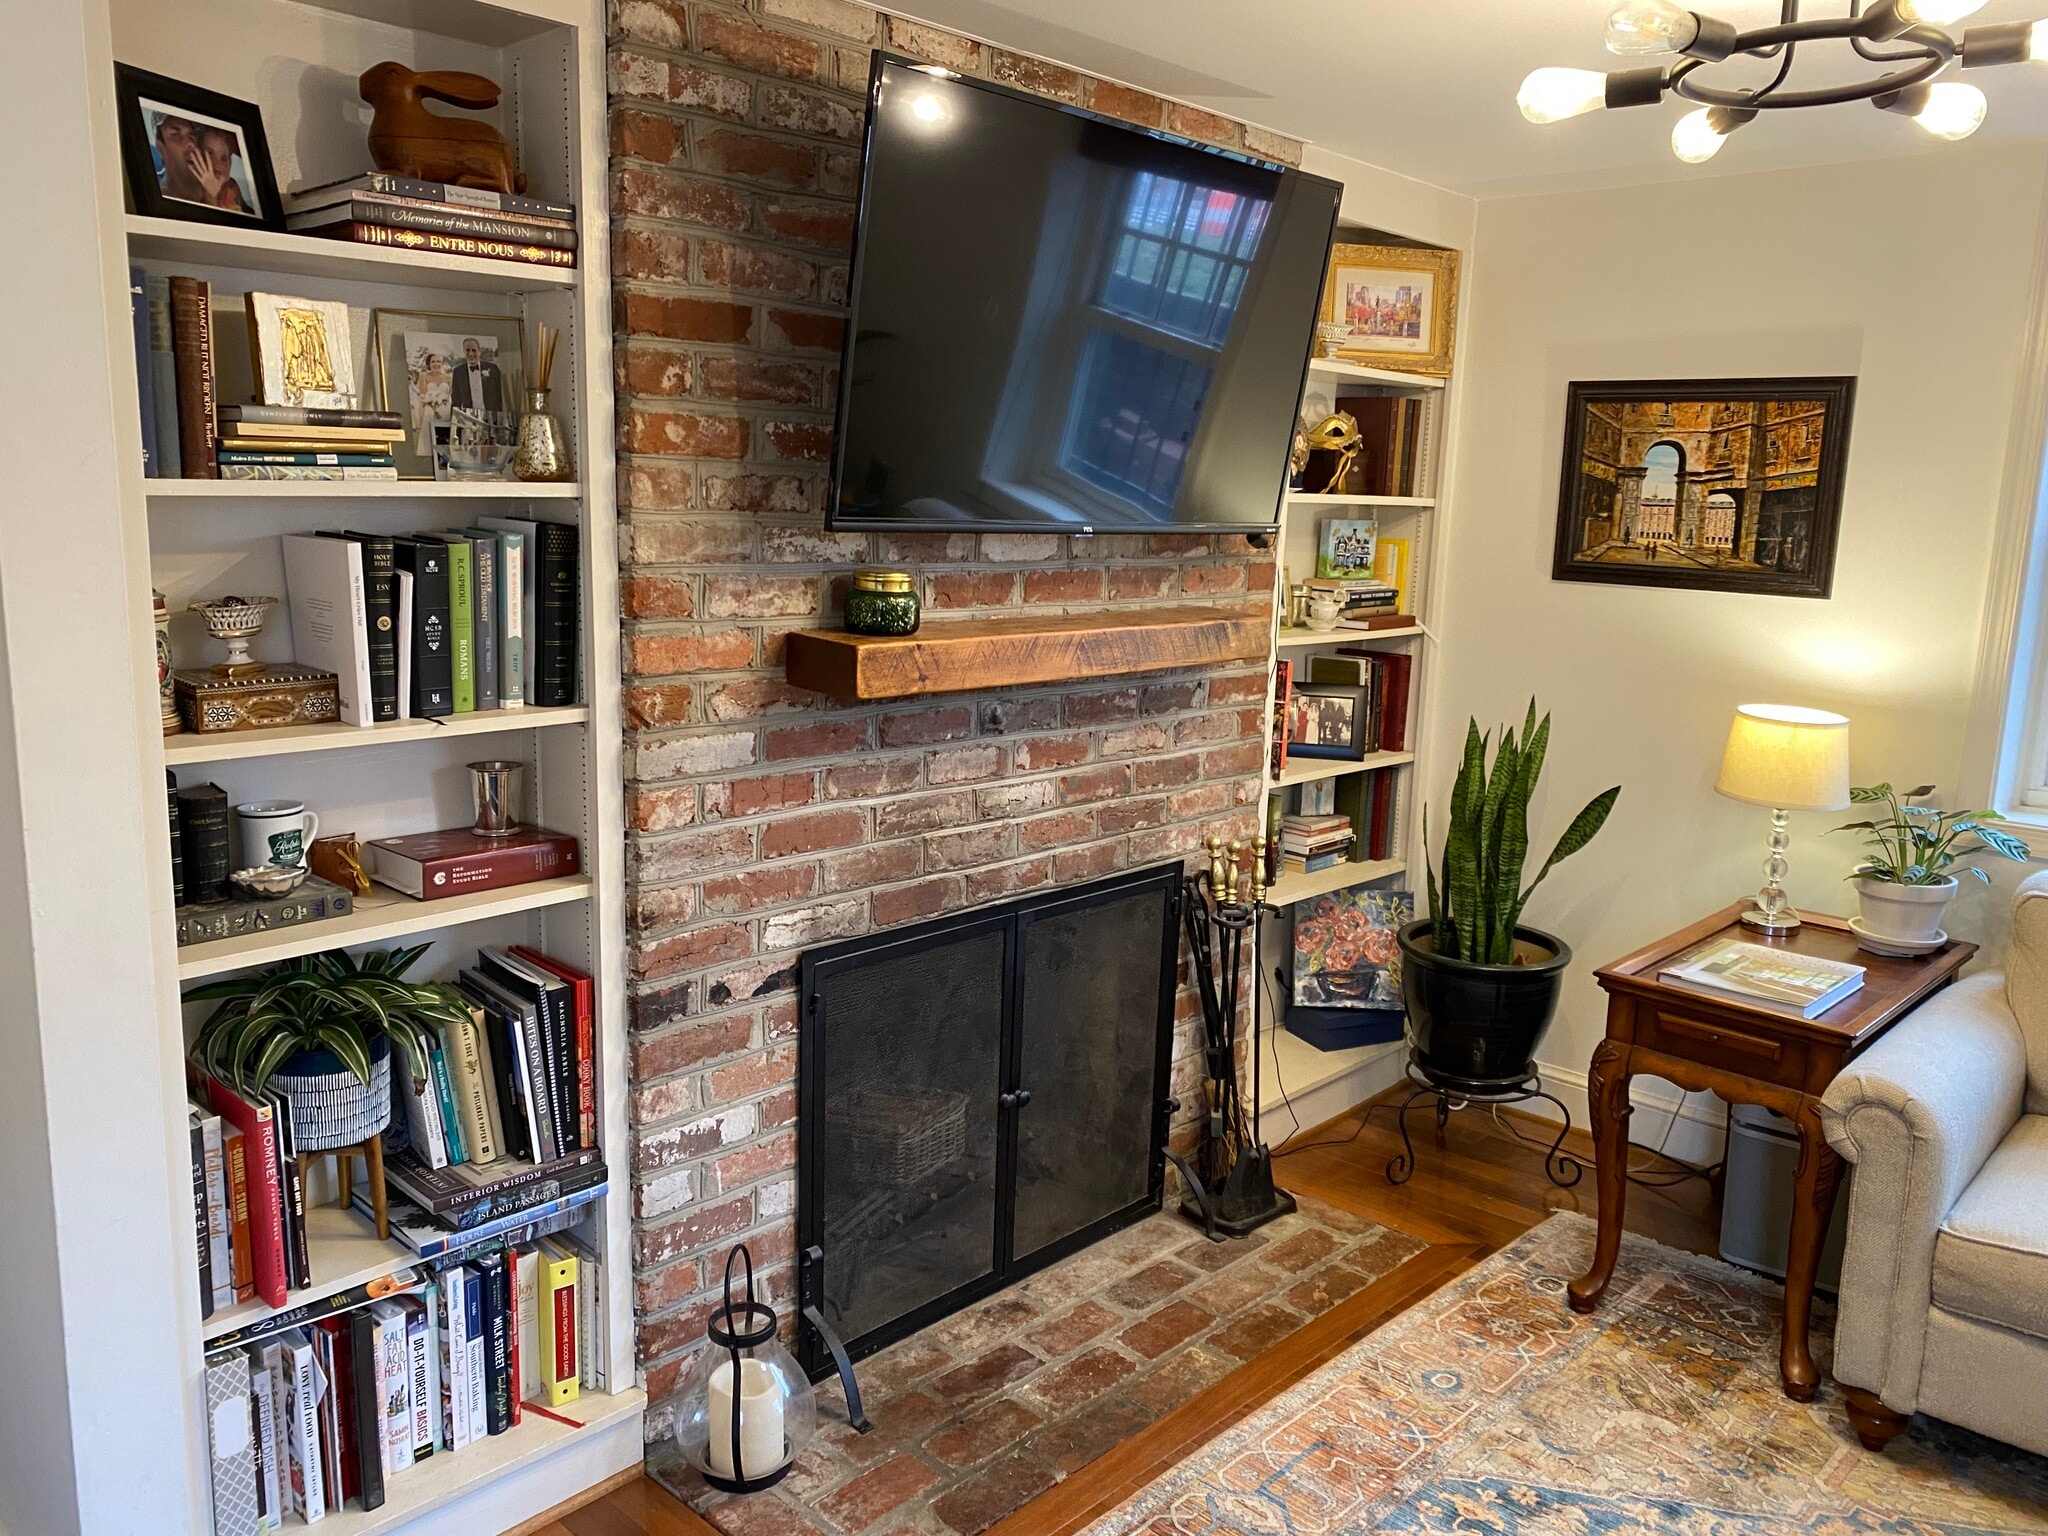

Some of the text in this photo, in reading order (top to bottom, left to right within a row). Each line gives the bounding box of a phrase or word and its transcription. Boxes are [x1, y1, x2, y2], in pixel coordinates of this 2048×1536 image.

[392, 210, 444, 226] Memories
[444, 218, 456, 230] of
[456, 218, 469, 230] the
[472, 220, 530, 238] MANSION
[430, 236, 514, 257] ENTRE NOUS
[460, 640, 468, 681] ROMANS
[452, 868, 492, 878] REFORMATION
[465, 1042, 474, 1057] EDGE
[558, 1001, 569, 1077] MAGNOLIA TABLE
[525, 1016, 548, 1115] BITES ON A BOARD
[582, 1059, 591, 1108] COOKY BOOK
[473, 1091, 484, 1121] POTLIKKER
[478, 1122, 488, 1144] PAPERS
[262, 1127, 276, 1185] ROMNEY
[232, 1148, 248, 1222] COOKING STORM
[450, 1170, 543, 1205] INTERIOR WISDOM
[476, 1189, 558, 1220] ISLAND PASSAGES
[456, 1215, 528, 1244] HOUSE WATER
[384, 1328, 404, 1345] SALT
[493, 1316, 504, 1338] MILK
[386, 1352, 406, 1367] ACID
[387, 1340, 403, 1356] FAT
[494, 1338, 505, 1369] STREET
[384, 1364, 406, 1378] HEAT
[469, 1344, 481, 1412] Southern Baking
[300, 1364, 314, 1438] LOVE real FOOD
[412, 1338, 429, 1442] DO-IT-YOURSELF BASICS
[258, 1394, 272, 1444] DEFINED
[390, 1424, 409, 1438] SAMIN
[262, 1446, 272, 1474] DISH
